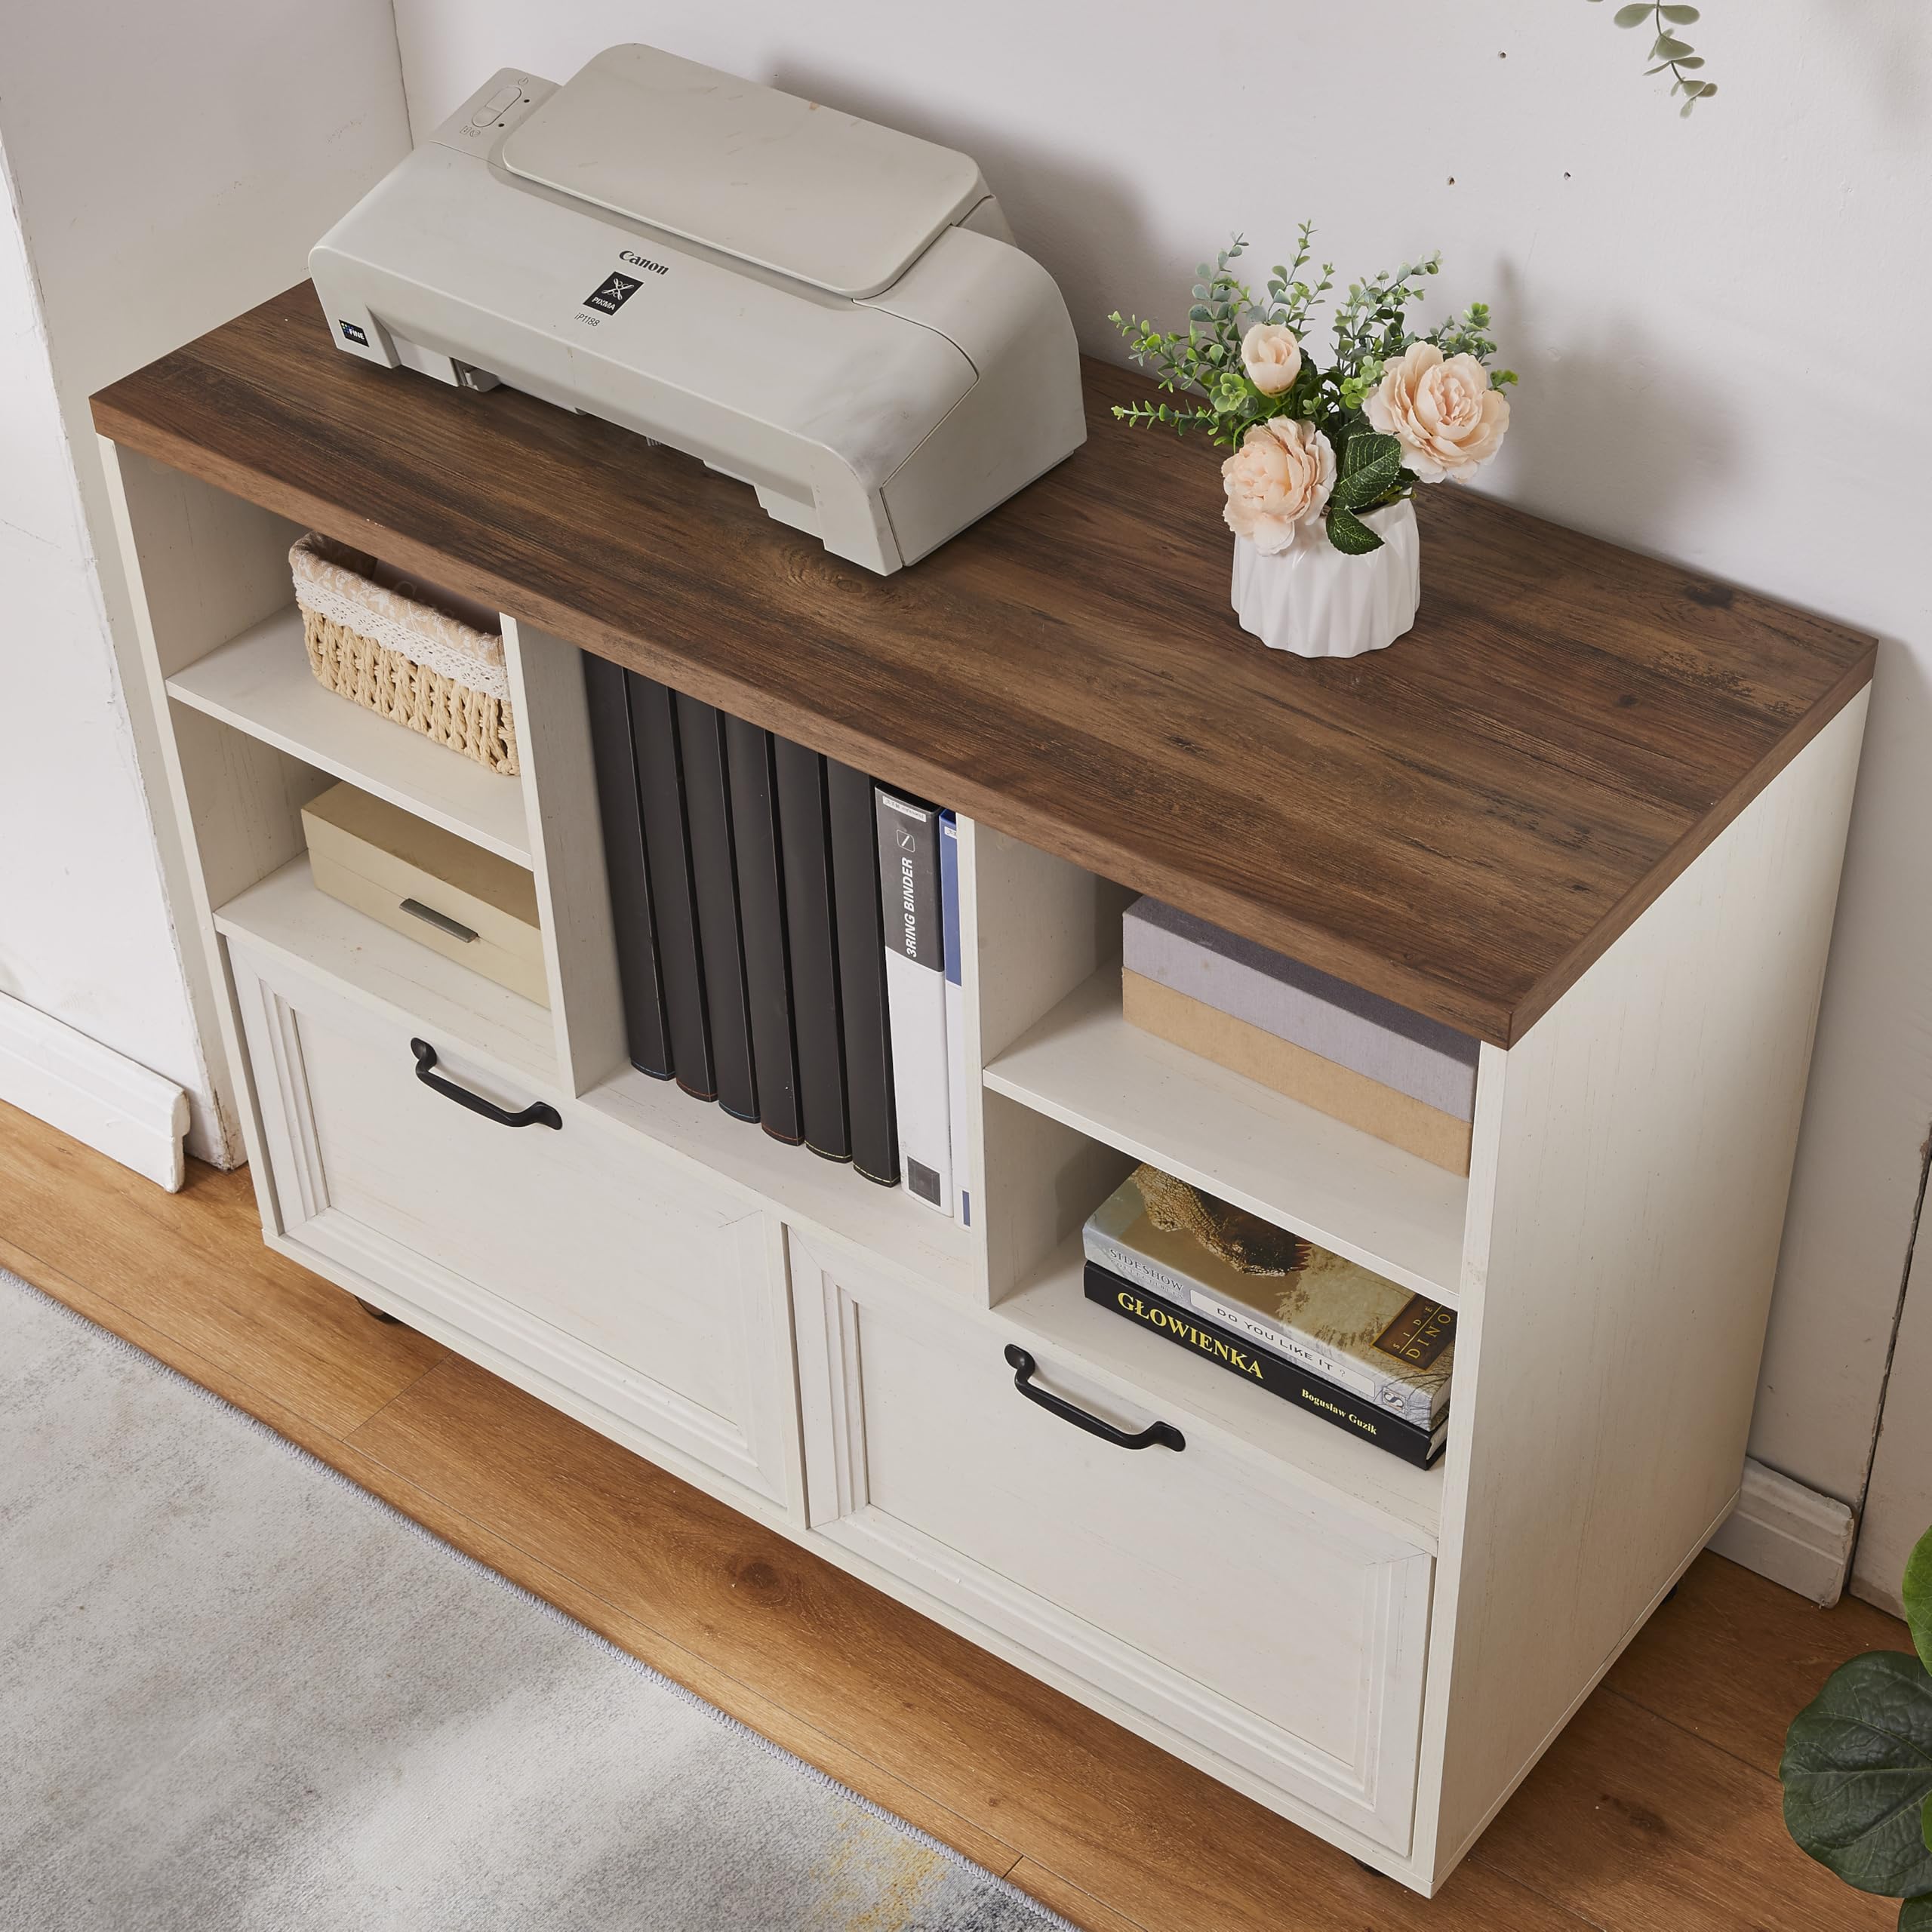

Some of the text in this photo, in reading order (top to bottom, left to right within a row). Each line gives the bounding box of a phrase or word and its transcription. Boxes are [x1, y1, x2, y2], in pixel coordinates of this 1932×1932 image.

[619, 251, 669, 275] Canon
[574, 312, 600, 327] iP1188
[592, 297, 616, 310] PIXMA
[349, 328, 365, 340] FINE
[902, 857, 917, 958] 3RING BINDER
[1110, 1249, 1183, 1292] SIDESHOW
[1118, 1292, 1264, 1380] GŁOWIENKA
[1217, 1308, 1238, 1322] DO
[1244, 1321, 1274, 1341] YOU
[1279, 1339, 1313, 1360] LIKE
[1319, 1358, 1334, 1371] IT
[1405, 1314, 1451, 1358] DINO
[1349, 1414, 1377, 1435] Guzik
